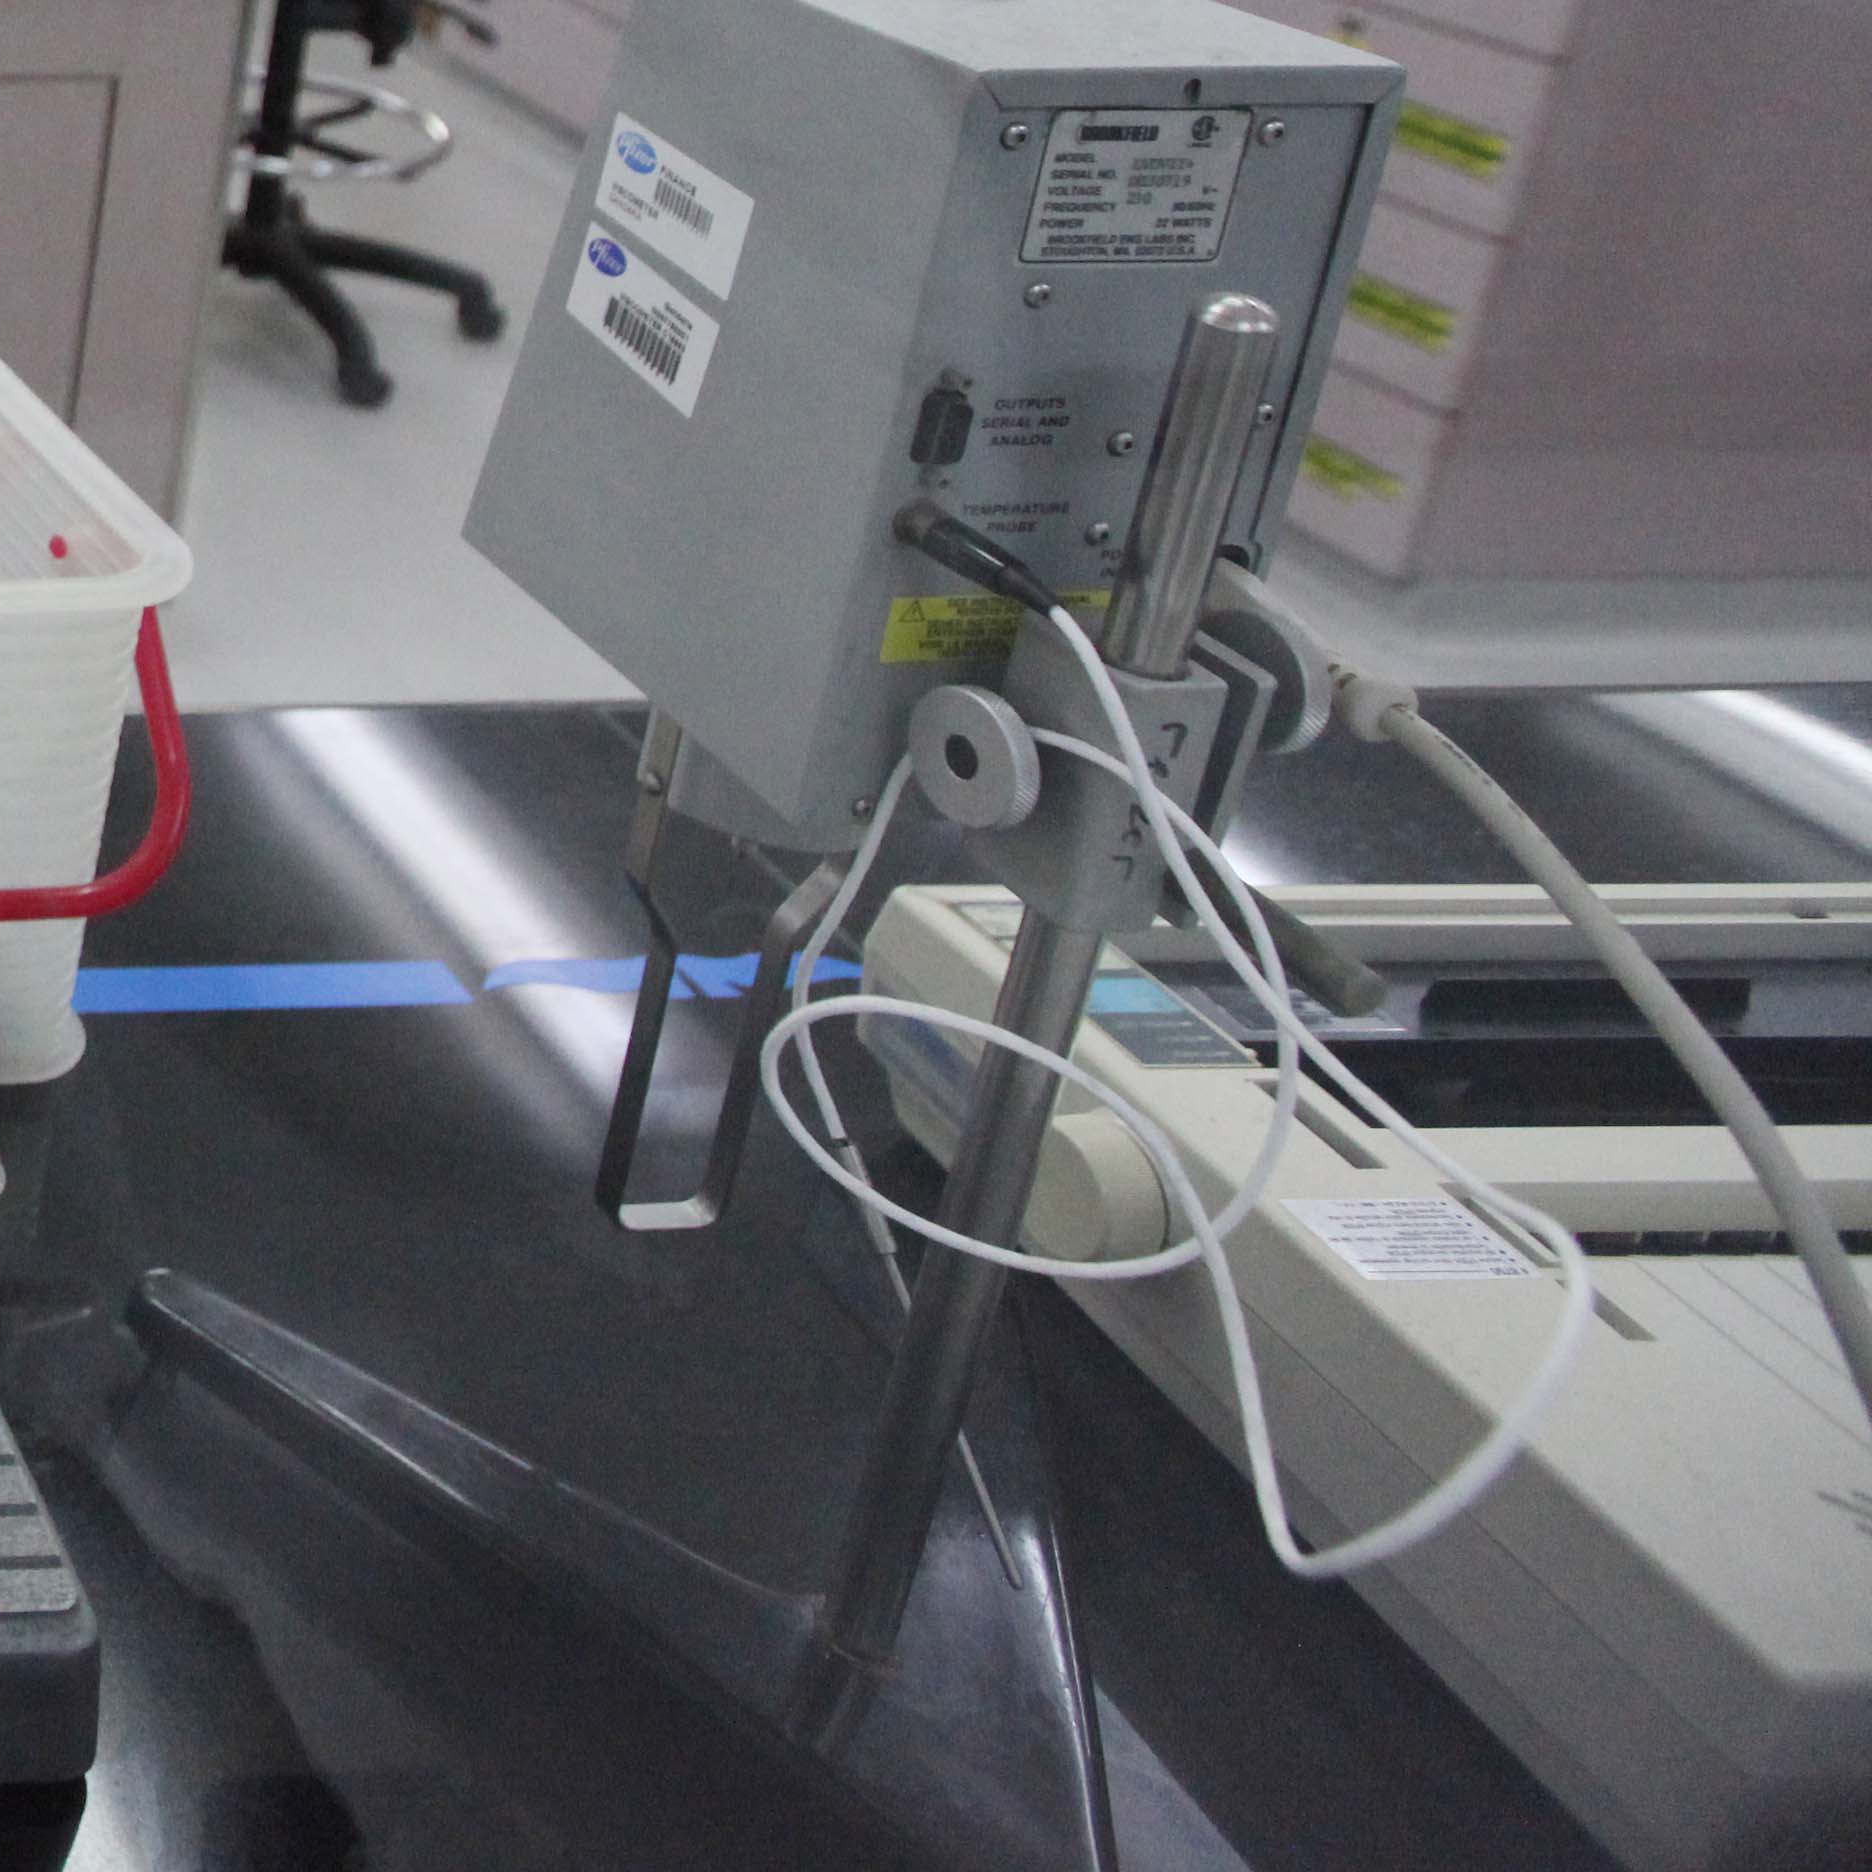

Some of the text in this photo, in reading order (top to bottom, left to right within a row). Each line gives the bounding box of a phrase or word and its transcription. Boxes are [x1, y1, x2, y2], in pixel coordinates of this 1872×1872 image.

[1079, 125, 1160, 142] BROOKFIELD
[1054, 153, 1096, 164] MODEL
[1051, 169, 1092, 179] SERIAL
[1048, 186, 1103, 196] VOLTAGE
[1043, 202, 1116, 212] FREQUENCY
[1040, 218, 1085, 228] POWER
[1048, 234, 1118, 244] BROOKFIELD
[994, 397, 1066, 411] OUTPUTS
[981, 414, 1071, 428] SERIAL AND
[990, 433, 1054, 447] ANALOG
[964, 502, 1071, 516] TEMPERATURE
[986, 520, 1038, 534] PROBE
